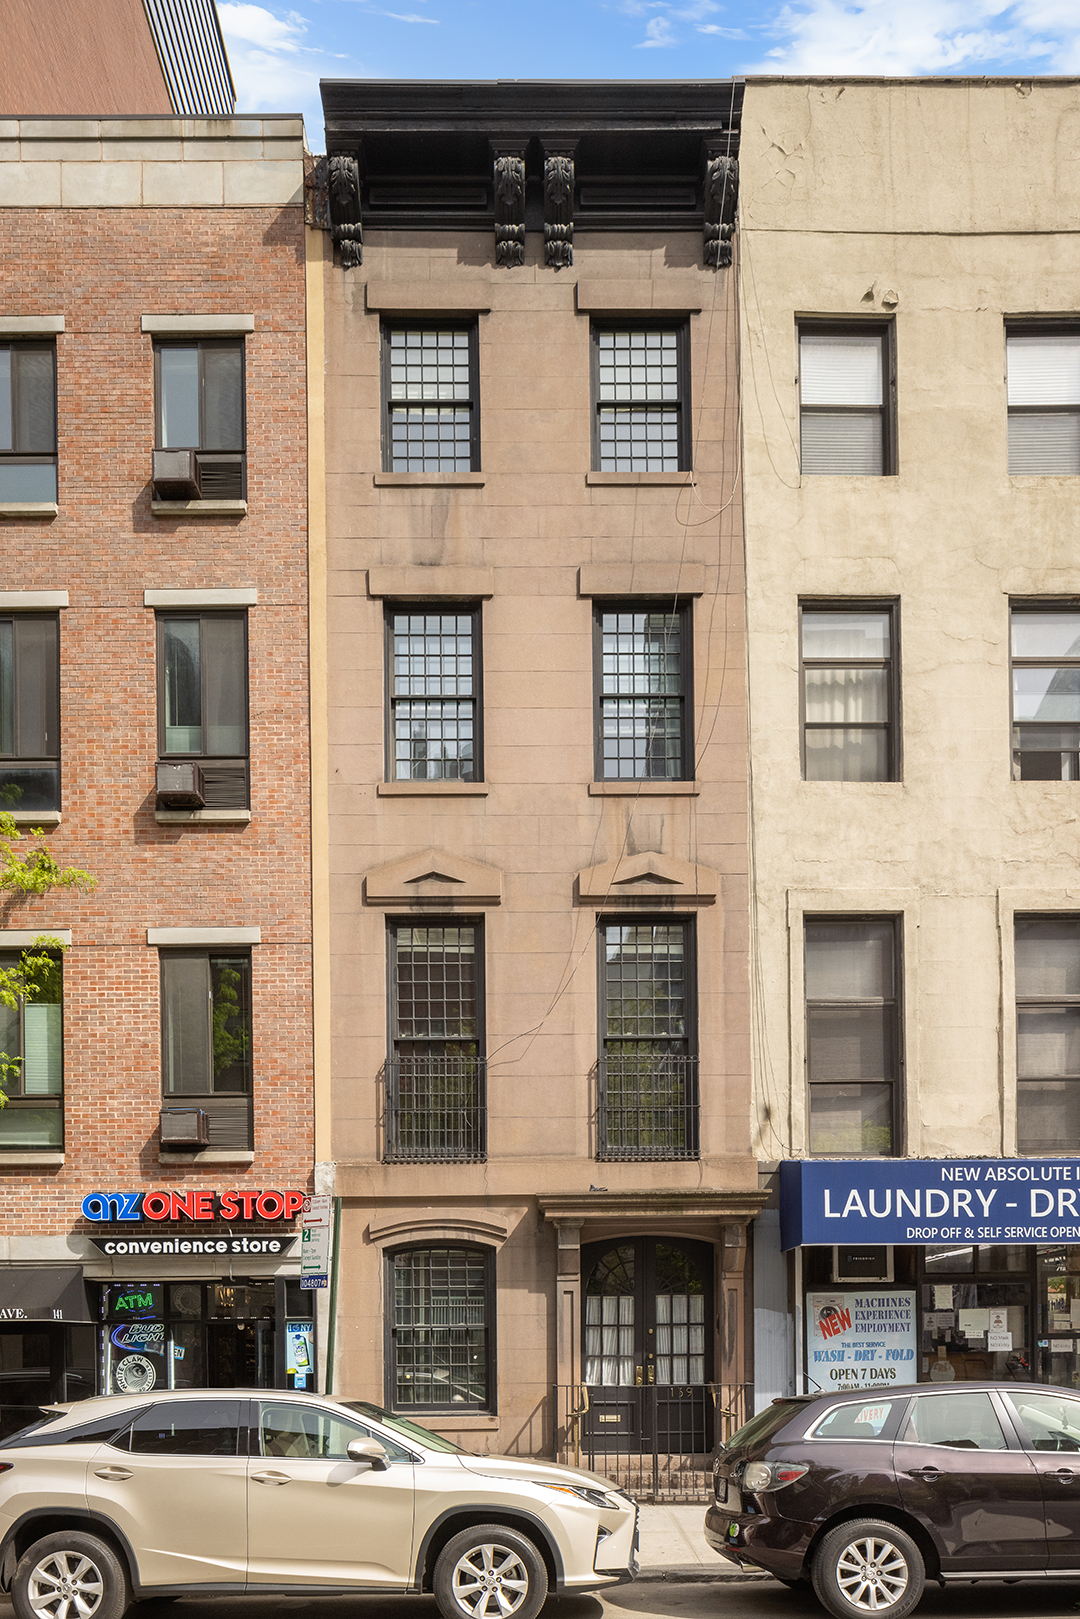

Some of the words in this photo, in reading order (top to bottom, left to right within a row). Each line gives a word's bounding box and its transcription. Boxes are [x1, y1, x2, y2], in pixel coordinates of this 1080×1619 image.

[941, 1167, 981, 1182] NEW
[984, 1166, 1072, 1182] ABSOLUTE
[143, 1191, 214, 1221] ONE
[220, 1190, 303, 1221] STOP
[824, 1188, 998, 1218] LAUNDRY
[1030, 1188, 1080, 1218] DR
[303, 1229, 309, 1241] 2
[906, 1227, 939, 1239] DROP
[940, 1227, 962, 1239] OFF
[964, 1227, 975, 1239] &
[977, 1226, 1002, 1238] SELF
[1004, 1226, 1048, 1238] SERVICE
[1050, 1226, 1080, 1238] OPEN
[104, 1238, 228, 1255] convenience
[232, 1237, 281, 1254] store
[115, 1292, 153, 1311] ATM
[854, 1297, 911, 1308] MACHINES
[0, 1308, 28, 1319] AVE.
[53, 1309, 63, 1319] 141
[854, 1309, 911, 1320] EXPERIENCE
[128, 1323, 165, 1334] BUD
[818, 1307, 852, 1340] NEW
[854, 1322, 911, 1333] EMPLOYMENT
[122, 1355, 144, 1367] CLAW
[813, 1350, 845, 1362] WASH
[854, 1349, 877, 1362] DRY
[885, 1348, 915, 1361] FOLD
[117, 1366, 128, 1389] WHITE
[829, 1368, 858, 1380] OPEN
[860, 1368, 867, 1380] 7
[869, 1367, 897, 1380] DAYS
[670, 1387, 692, 1398] 139
[855, 1407, 885, 1423] LIVERY
